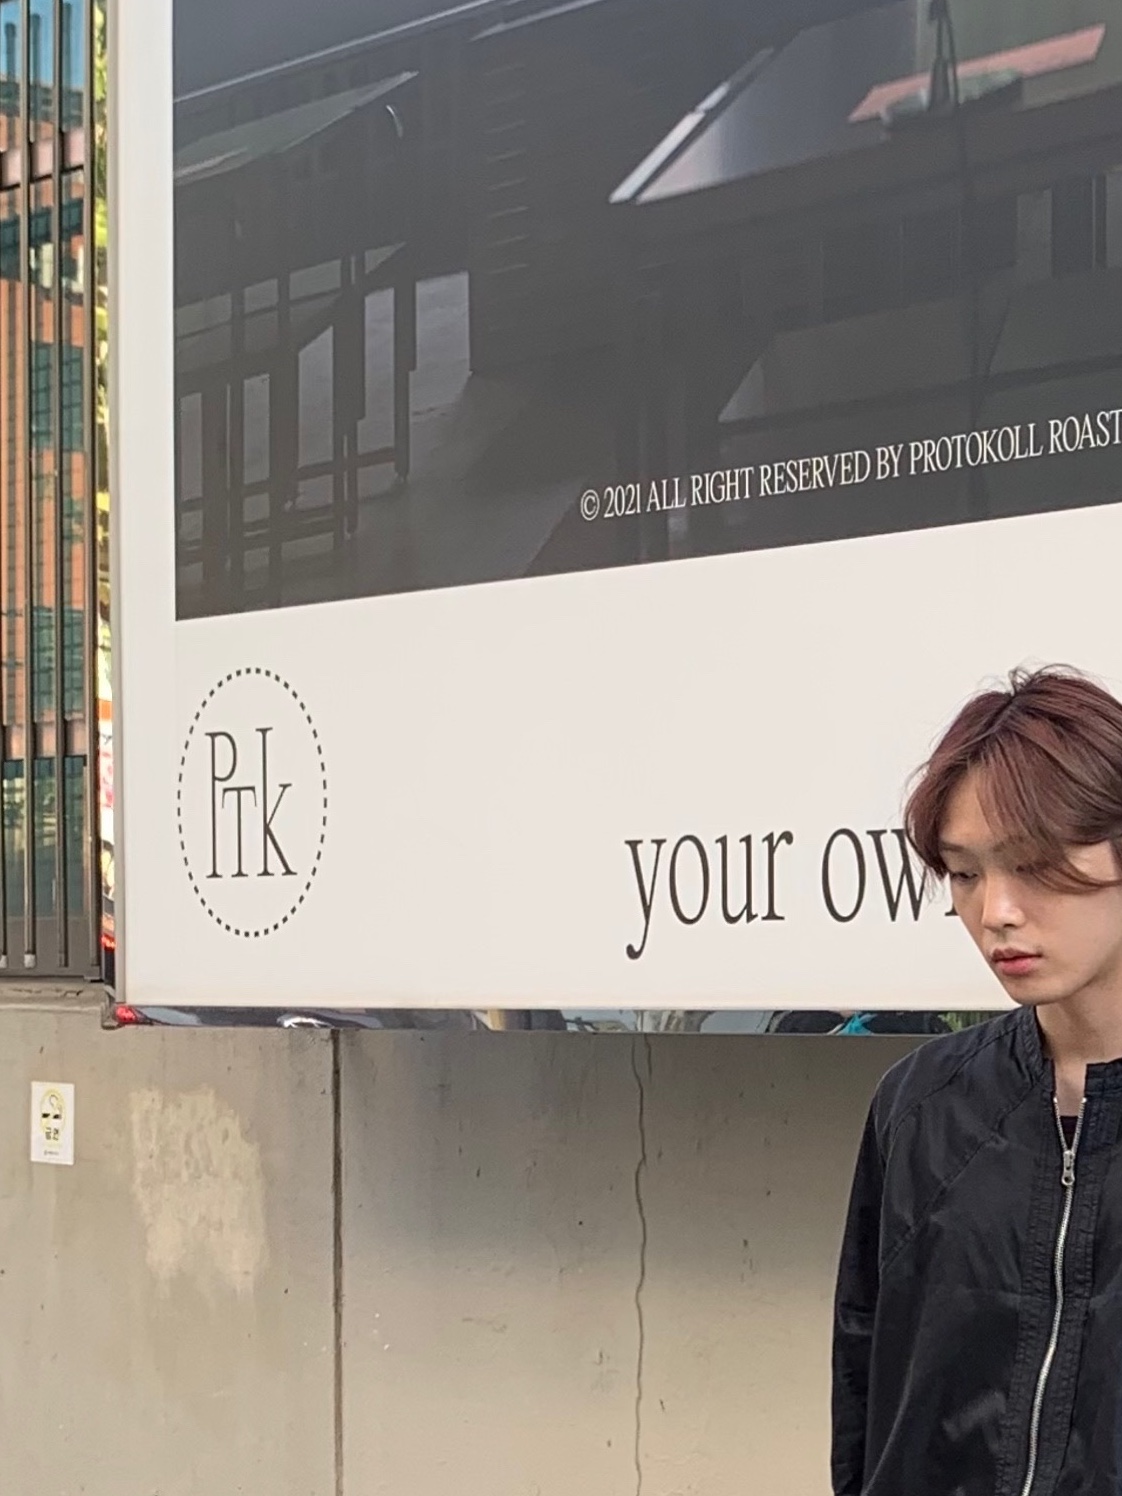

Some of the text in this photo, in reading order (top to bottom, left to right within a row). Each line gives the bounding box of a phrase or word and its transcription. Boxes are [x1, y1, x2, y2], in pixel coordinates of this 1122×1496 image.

[603, 483, 641, 518] 2021
[646, 477, 687, 513] ALL
[690, 466, 754, 506] RIGHT
[759, 450, 871, 497] RESERVED
[875, 444, 904, 480] BY
[908, 425, 1044, 475] PROTOKOLL
[624, 830, 795, 961] your
[821, 826, 959, 925] ow
